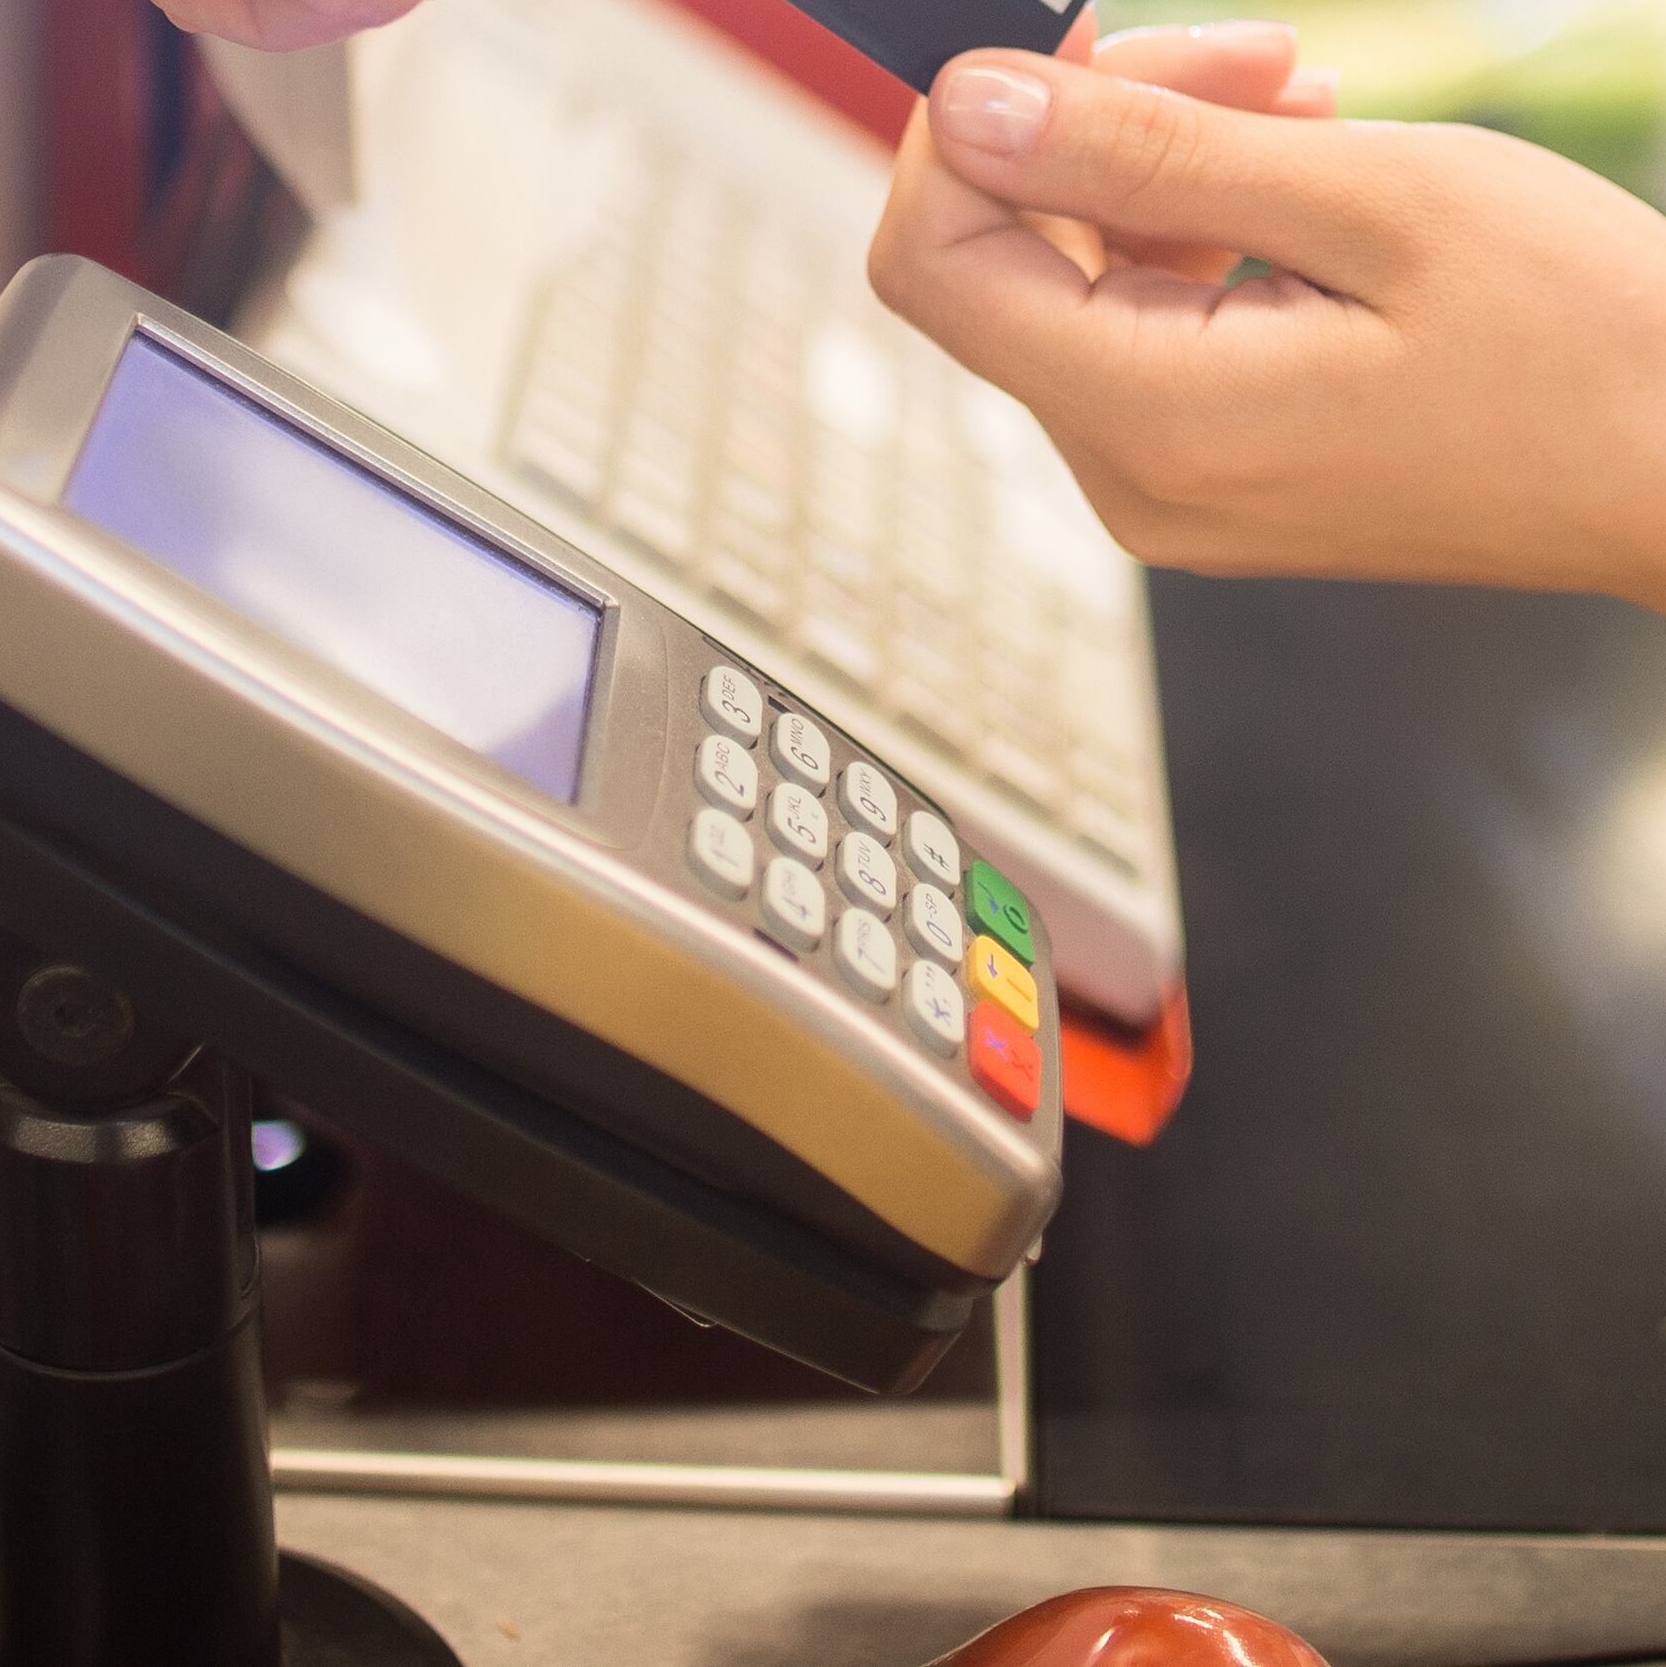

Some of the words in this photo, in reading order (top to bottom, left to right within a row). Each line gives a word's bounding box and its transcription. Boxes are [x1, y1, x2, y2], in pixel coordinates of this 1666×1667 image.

[722, 674, 736, 701] DEF
[722, 700, 751, 723] 3
[789, 718, 804, 747] MNO
[715, 741, 731, 771] ABC
[790, 746, 819, 770] 6
[714, 771, 745, 797] 2
[788, 796, 802, 820] JKL
[860, 796, 887, 822] 9
[787, 817, 817, 844] 5
[857, 841, 872, 870] TUV
[858, 870, 887, 895] 8
[926, 920, 953, 947] 0
